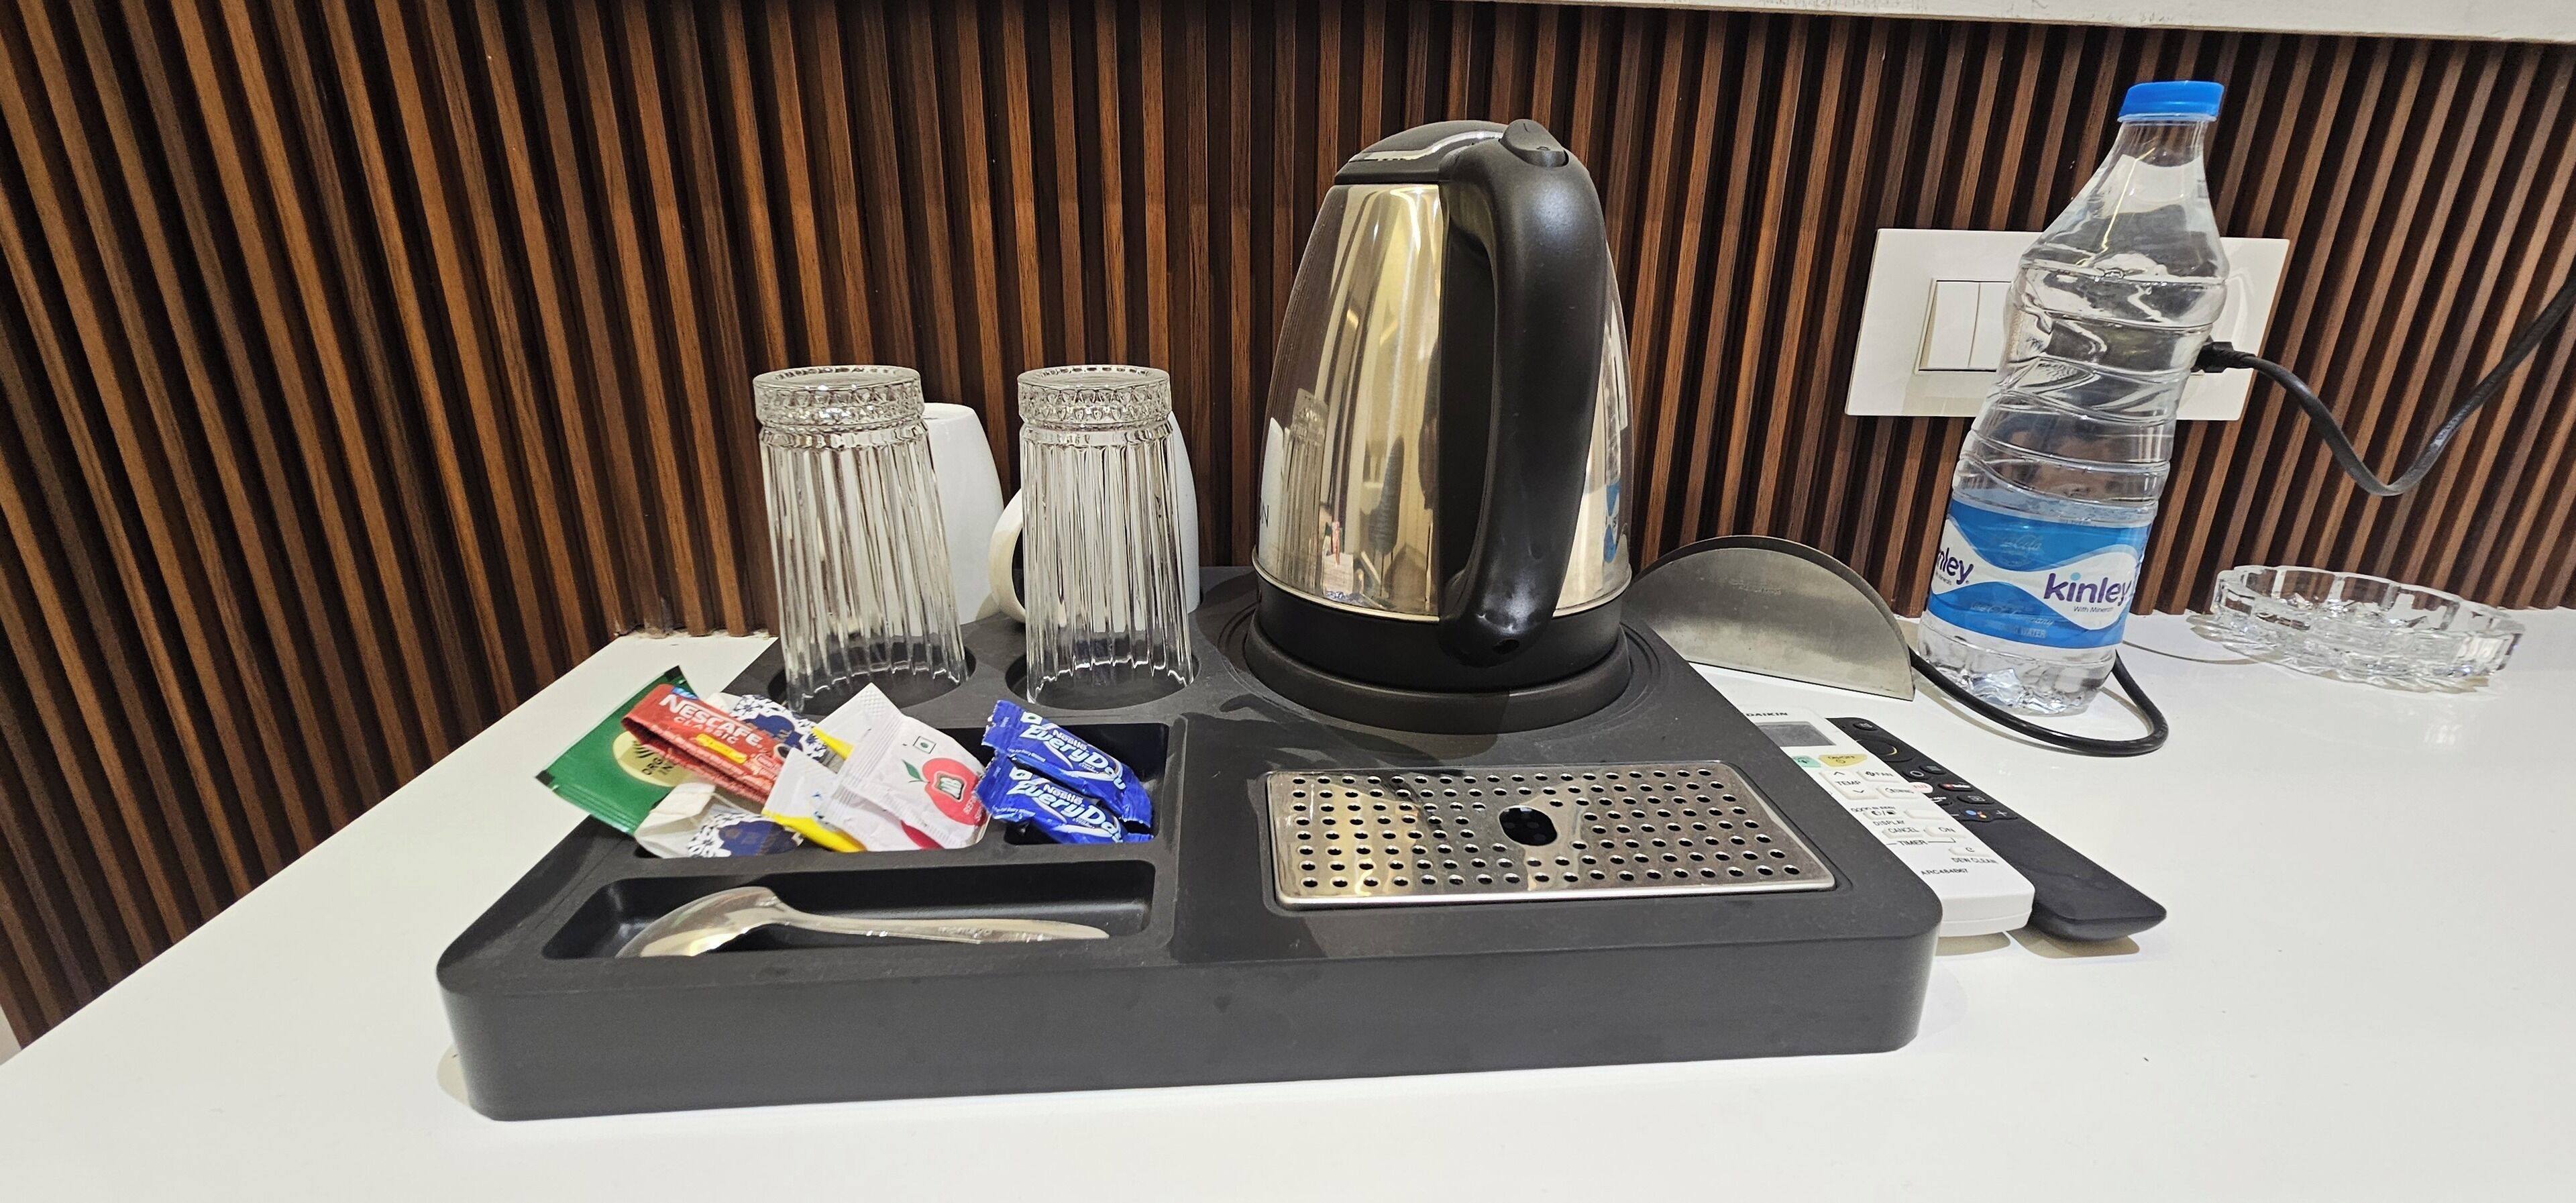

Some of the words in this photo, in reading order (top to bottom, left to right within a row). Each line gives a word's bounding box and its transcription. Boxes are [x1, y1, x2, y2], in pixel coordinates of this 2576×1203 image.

[1937, 547, 1974, 585] nley
[2043, 572, 2132, 607] kinley
[673, 716, 739, 745] CLASSIC
[641, 757, 663, 776] ORG
